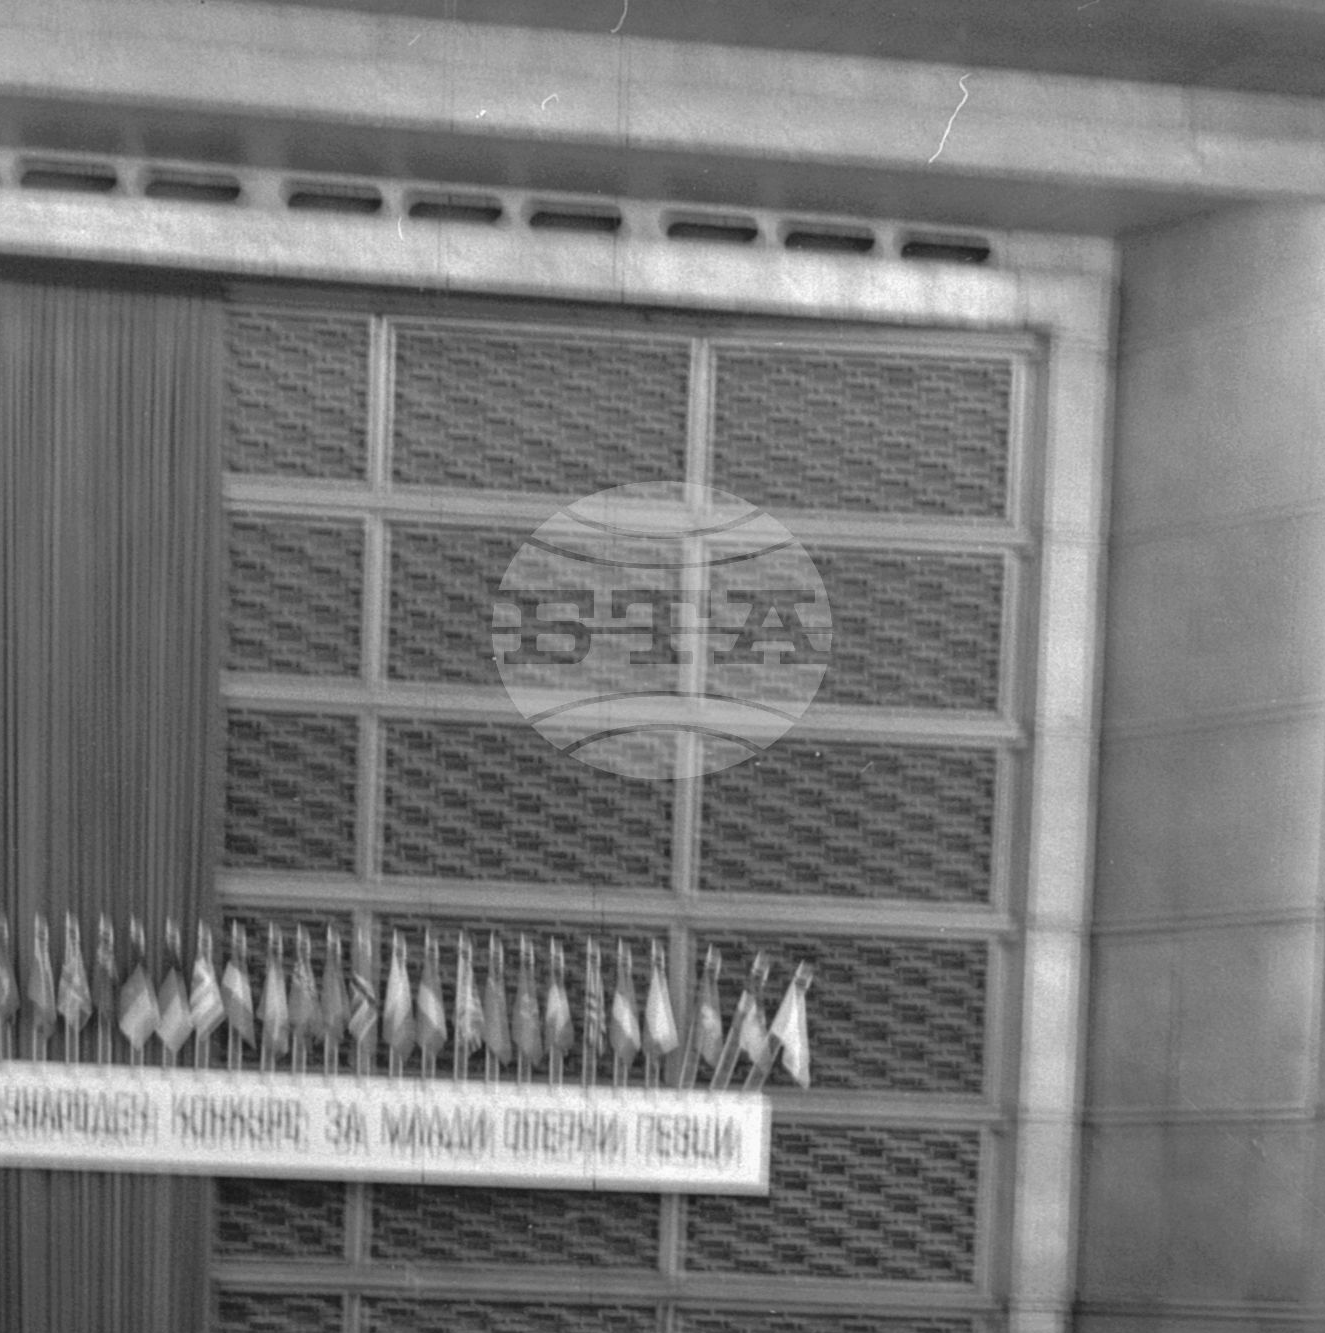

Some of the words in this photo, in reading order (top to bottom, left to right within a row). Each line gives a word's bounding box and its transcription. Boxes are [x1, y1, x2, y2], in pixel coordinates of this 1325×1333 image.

[174, 1092, 310, 1152] КОНКУРС
[324, 1099, 370, 1155] ЗА
[380, 1103, 495, 1161] МЛАДИ
[503, 1108, 628, 1167] ОПЕРНИ
[635, 1113, 743, 1170] ПЕВЦИ
